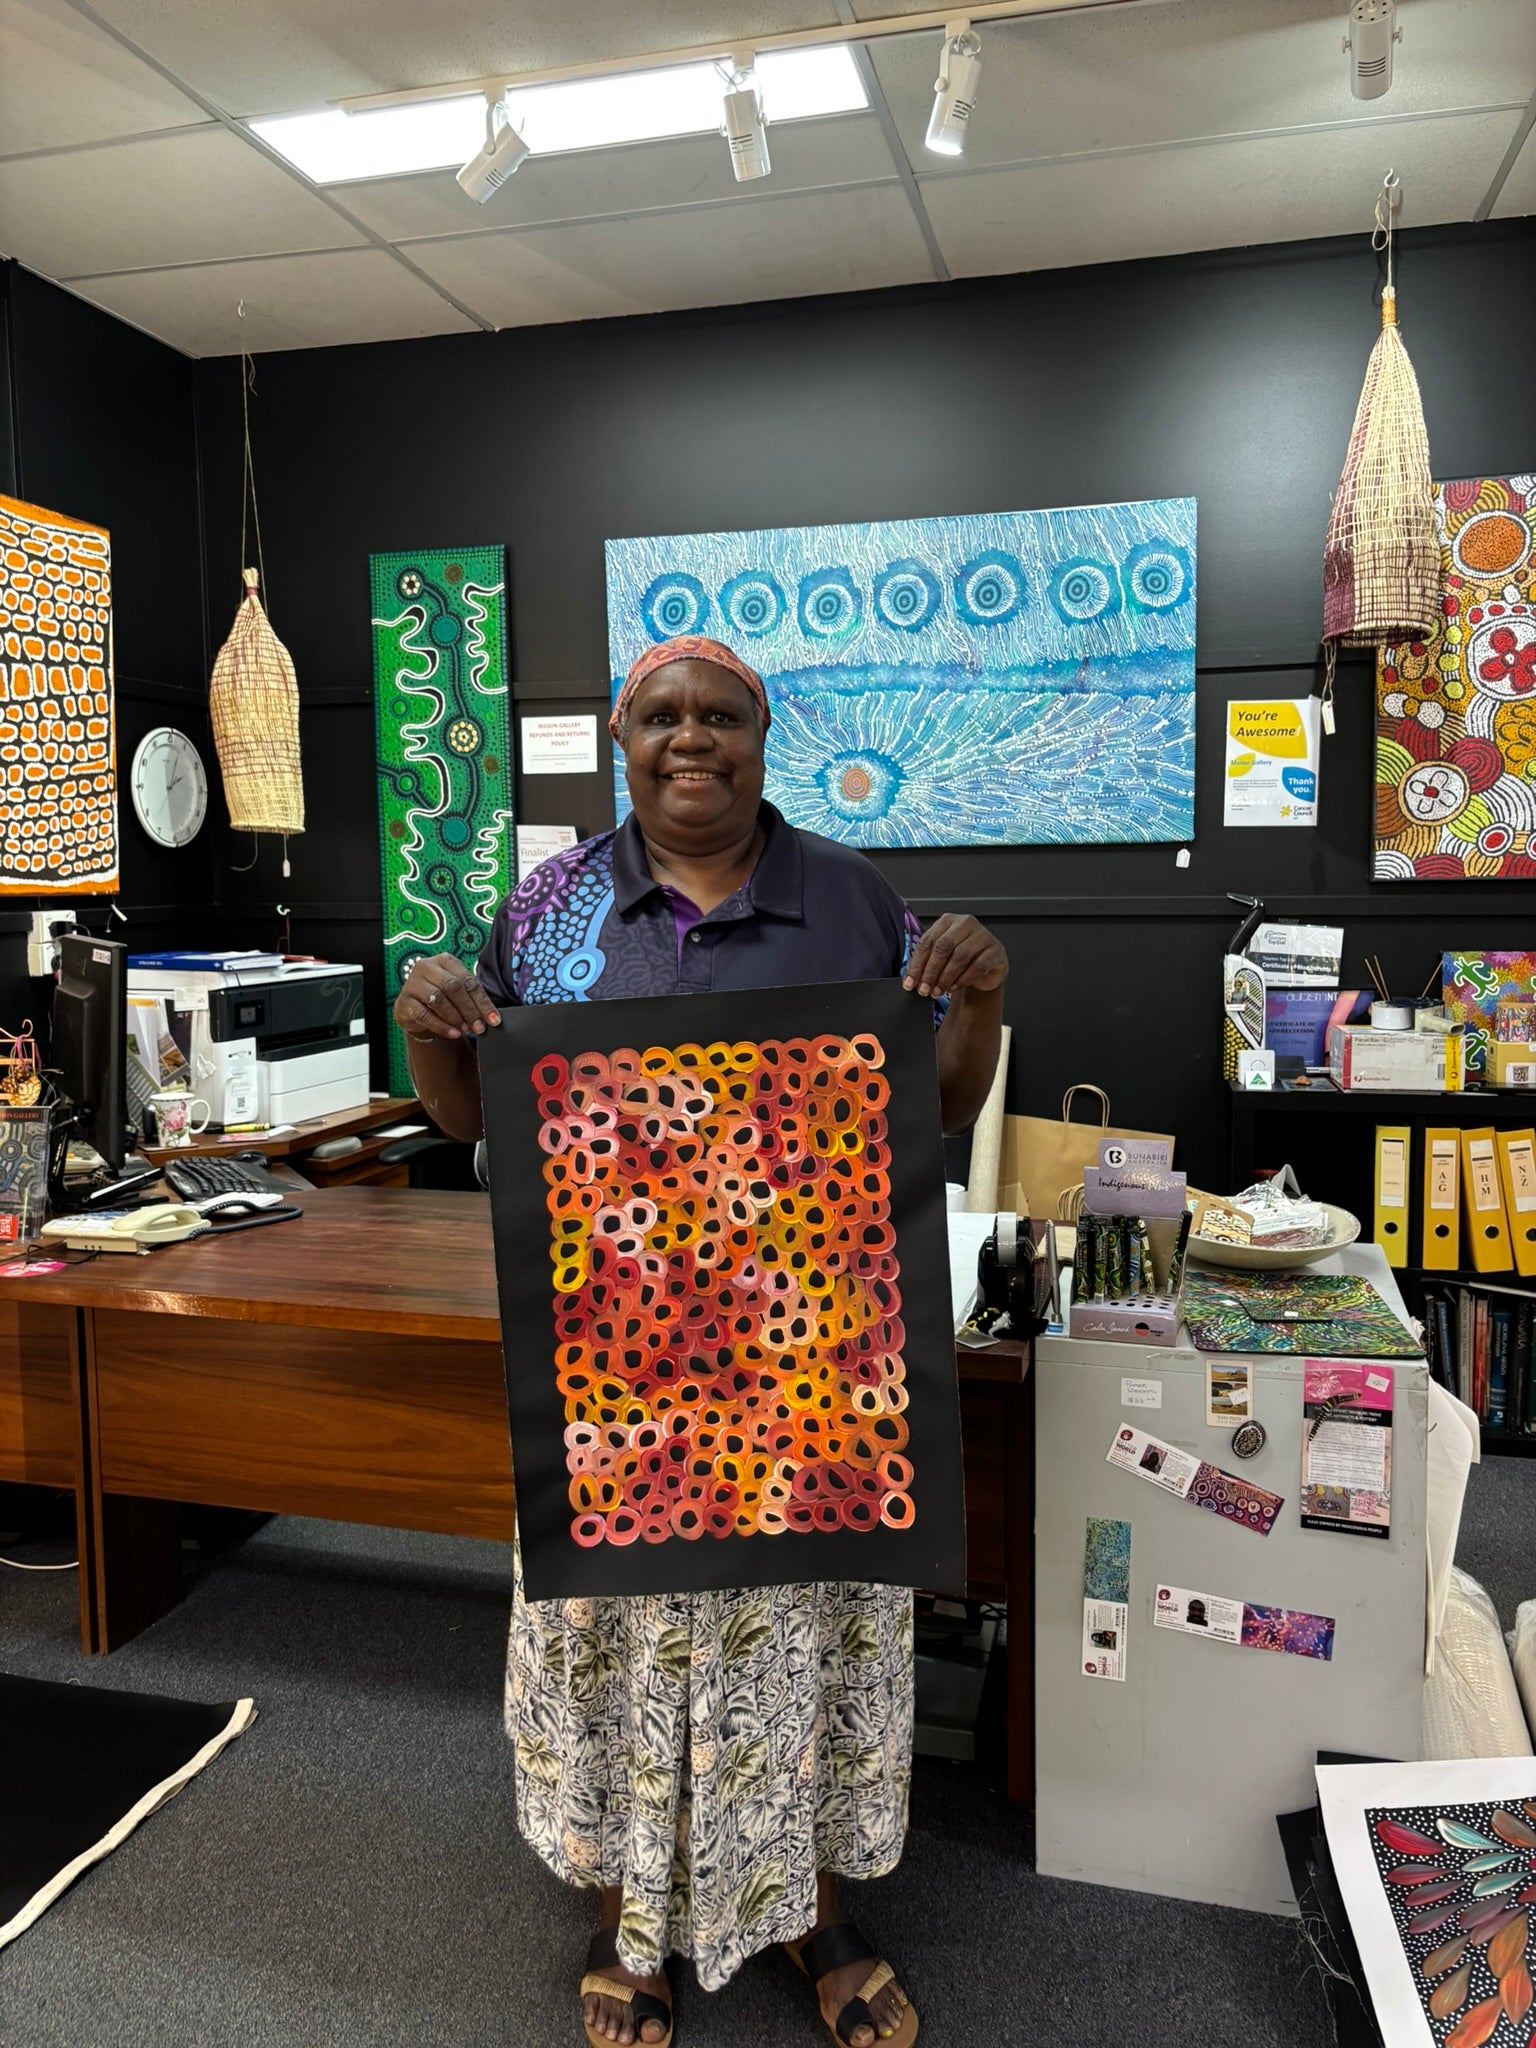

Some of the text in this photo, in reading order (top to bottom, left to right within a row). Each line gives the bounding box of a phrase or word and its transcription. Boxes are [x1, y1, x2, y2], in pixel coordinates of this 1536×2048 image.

[1237, 710, 1278, 721] You're
[1235, 724, 1301, 737] Awesome!
[1288, 777, 1314, 785] Thank
[1293, 786, 1311, 794] you.
[1438, 1171, 1447, 1180] A
[1098, 1177, 1145, 1192] Indigenous
[1438, 1184, 1447, 1192] G
[1116, 1442, 1136, 1455] WORLD
[1157, 1604, 1179, 1612] WORLD
